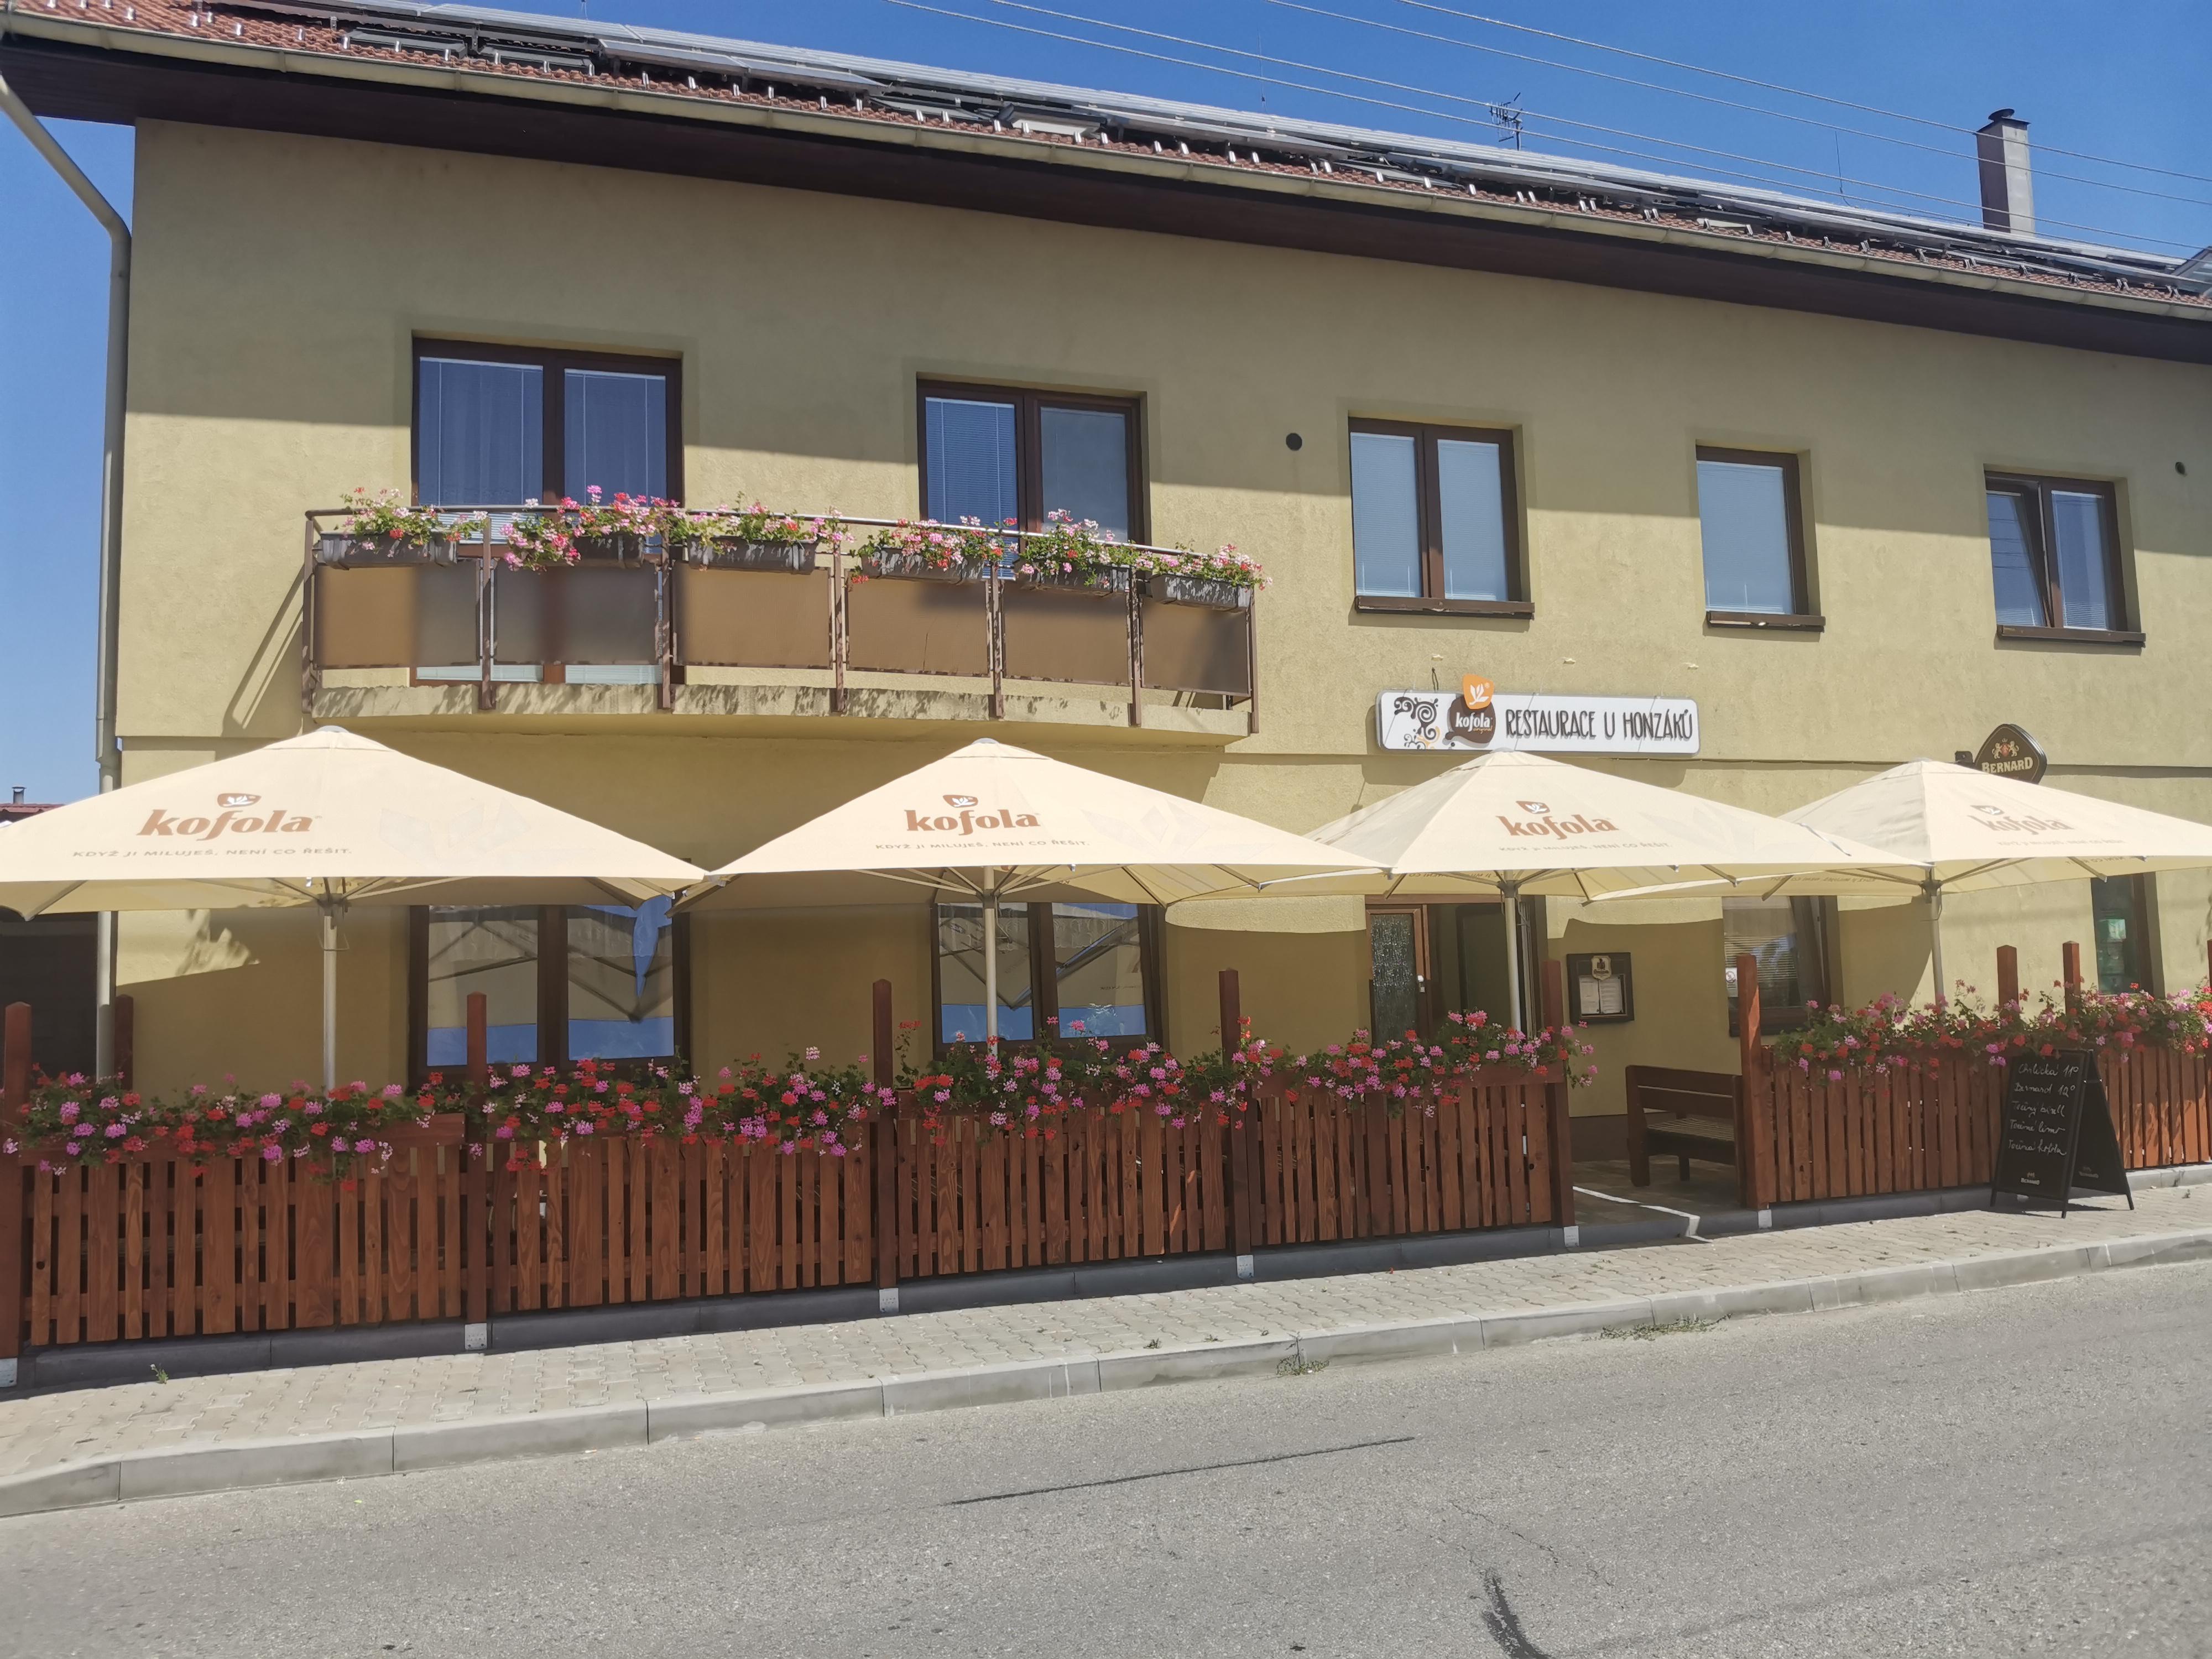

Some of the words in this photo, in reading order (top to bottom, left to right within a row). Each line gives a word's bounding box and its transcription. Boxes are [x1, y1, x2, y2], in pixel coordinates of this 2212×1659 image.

[1455, 712, 1491, 732] kofola
[1505, 708, 1597, 739] RESTAURACE
[1604, 712, 1615, 738] U
[1623, 708, 1693, 740] HONZÁKŮ
[1981, 757, 2033, 774] BERNARD
[136, 808, 315, 841] kofola
[904, 809, 1041, 836] kofola
[1495, 814, 1619, 839] kofola
[1967, 815, 2075, 835] kofola
[2015, 1082, 2053, 1094] Bernard
